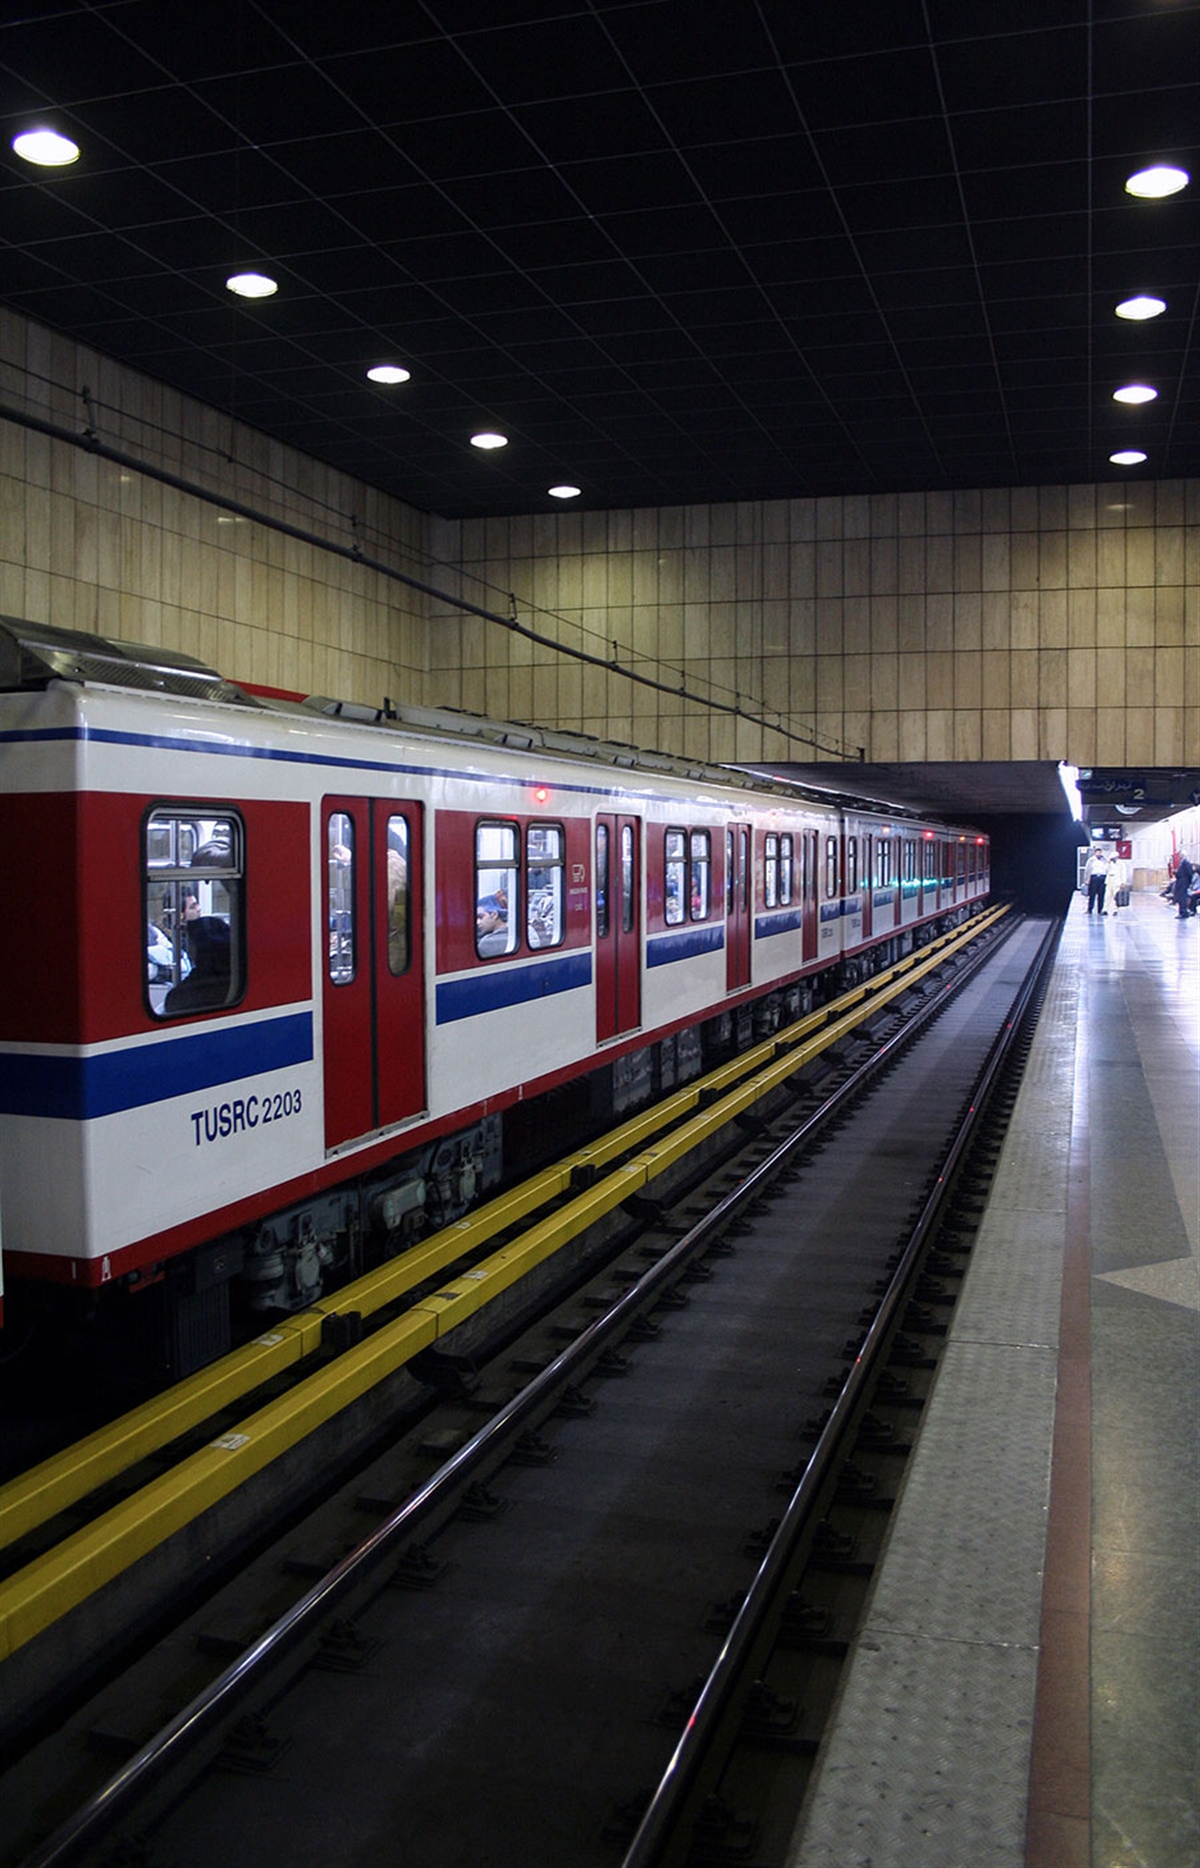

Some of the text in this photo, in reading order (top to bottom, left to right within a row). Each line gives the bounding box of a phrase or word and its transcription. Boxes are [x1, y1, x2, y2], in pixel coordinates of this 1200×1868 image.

[1133, 788, 1145, 800] 2
[191, 1089, 302, 1146] TUSRC 2203
